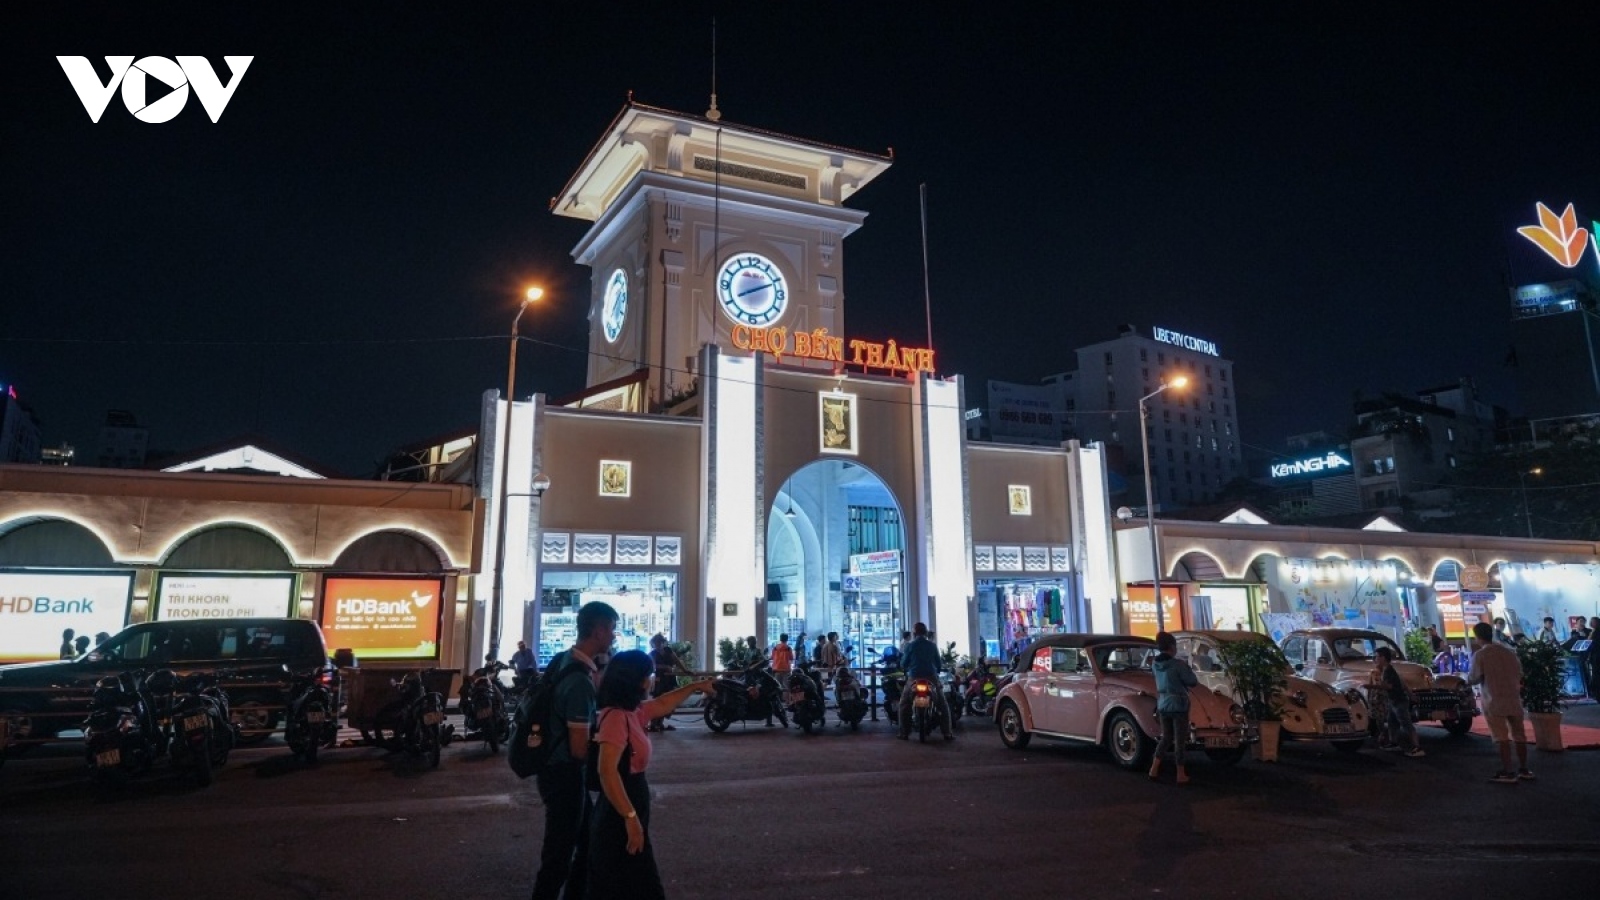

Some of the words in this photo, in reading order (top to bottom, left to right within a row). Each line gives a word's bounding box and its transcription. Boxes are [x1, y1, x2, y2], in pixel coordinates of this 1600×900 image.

[747, 256, 761, 267] 12
[720, 280, 729, 290] 9
[776, 290, 785, 300] 3
[748, 315, 757, 325] 6
[1153, 325, 1184, 348] LIBERTY
[1184, 335, 1219, 357] CENTRAL
[731, 323, 788, 358] CHỢ
[794, 328, 844, 361] BẾN
[850, 339, 935, 373] THÀNH
[0, 597, 94, 613] HDBank
[335, 599, 412, 615] HDBank
